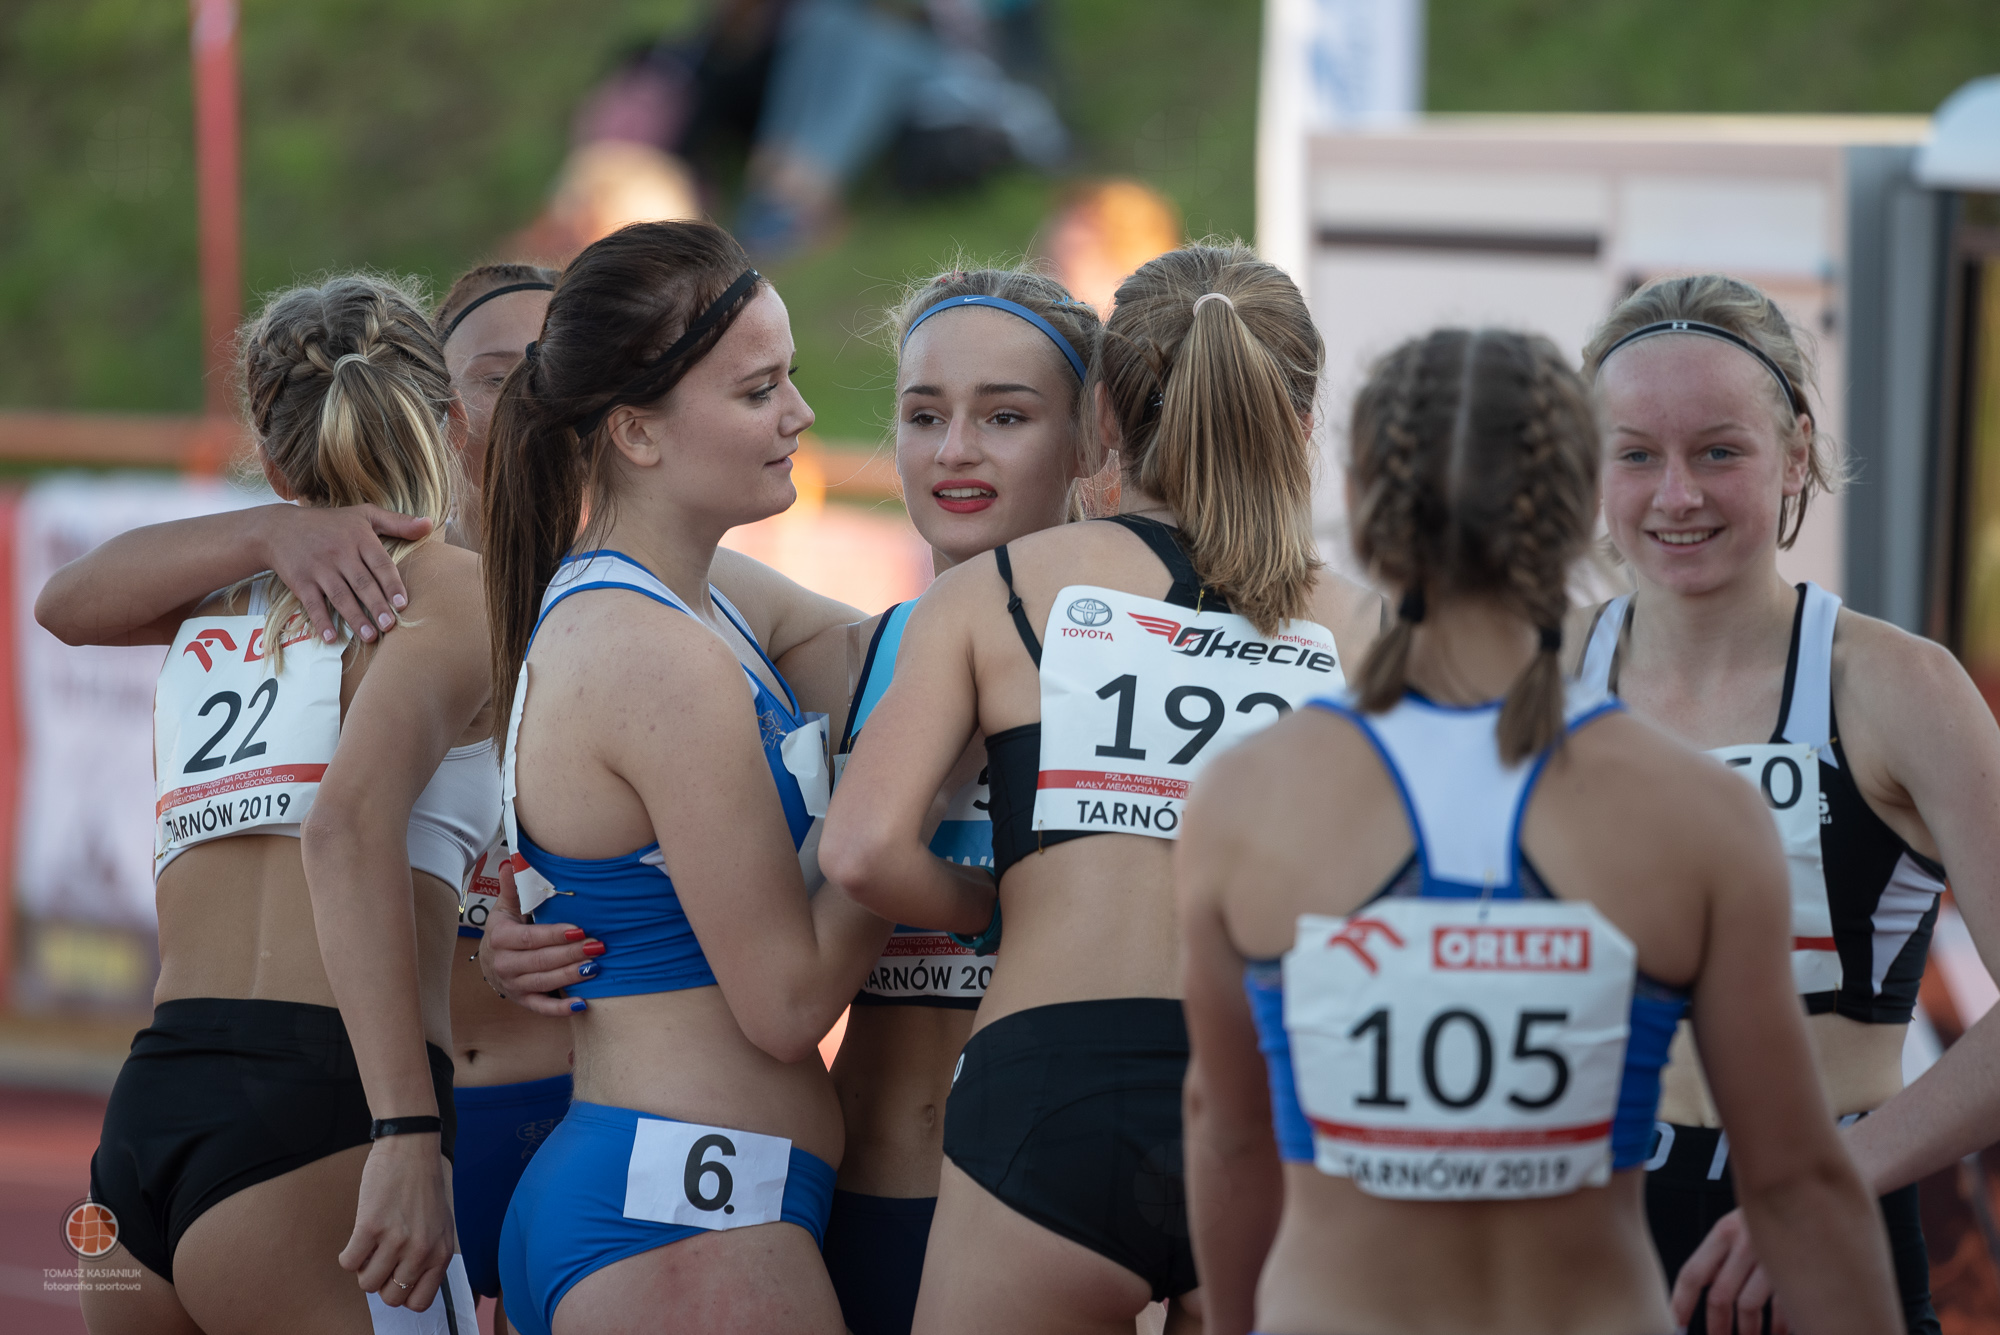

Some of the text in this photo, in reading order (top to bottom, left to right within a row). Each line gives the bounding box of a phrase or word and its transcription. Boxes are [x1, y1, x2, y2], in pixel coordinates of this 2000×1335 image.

[1061, 627, 1114, 642] TOYOTA
[1172, 625, 1336, 674] Okęcie
[183, 678, 279, 774] 22
[188, 775, 234, 794] MISTRZOSTWA
[234, 769, 260, 781] POLSKI
[204, 782, 235, 797] JANUSZA
[236, 774, 295, 790] KUSOCIŃSKIEGO
[1075, 780, 1191, 799] MAŁY MEMORIAŁ JANU
[1104, 773, 1193, 790] PZLA MISTRZOST
[166, 793, 291, 842] TARNÓW 2019
[1077, 801, 1179, 832] TARNÓ
[883, 947, 914, 956] ORIAŁ
[915, 946, 953, 955] JANUSZA
[889, 937, 950, 946] MISTRZOSTWA
[1440, 931, 1583, 967] ORLEN
[865, 959, 992, 990] ARNÓW 20
[1347, 1006, 1571, 1112] 105
[683, 1133, 737, 1215] 6.
[1495, 1155, 1571, 1189] 2019
